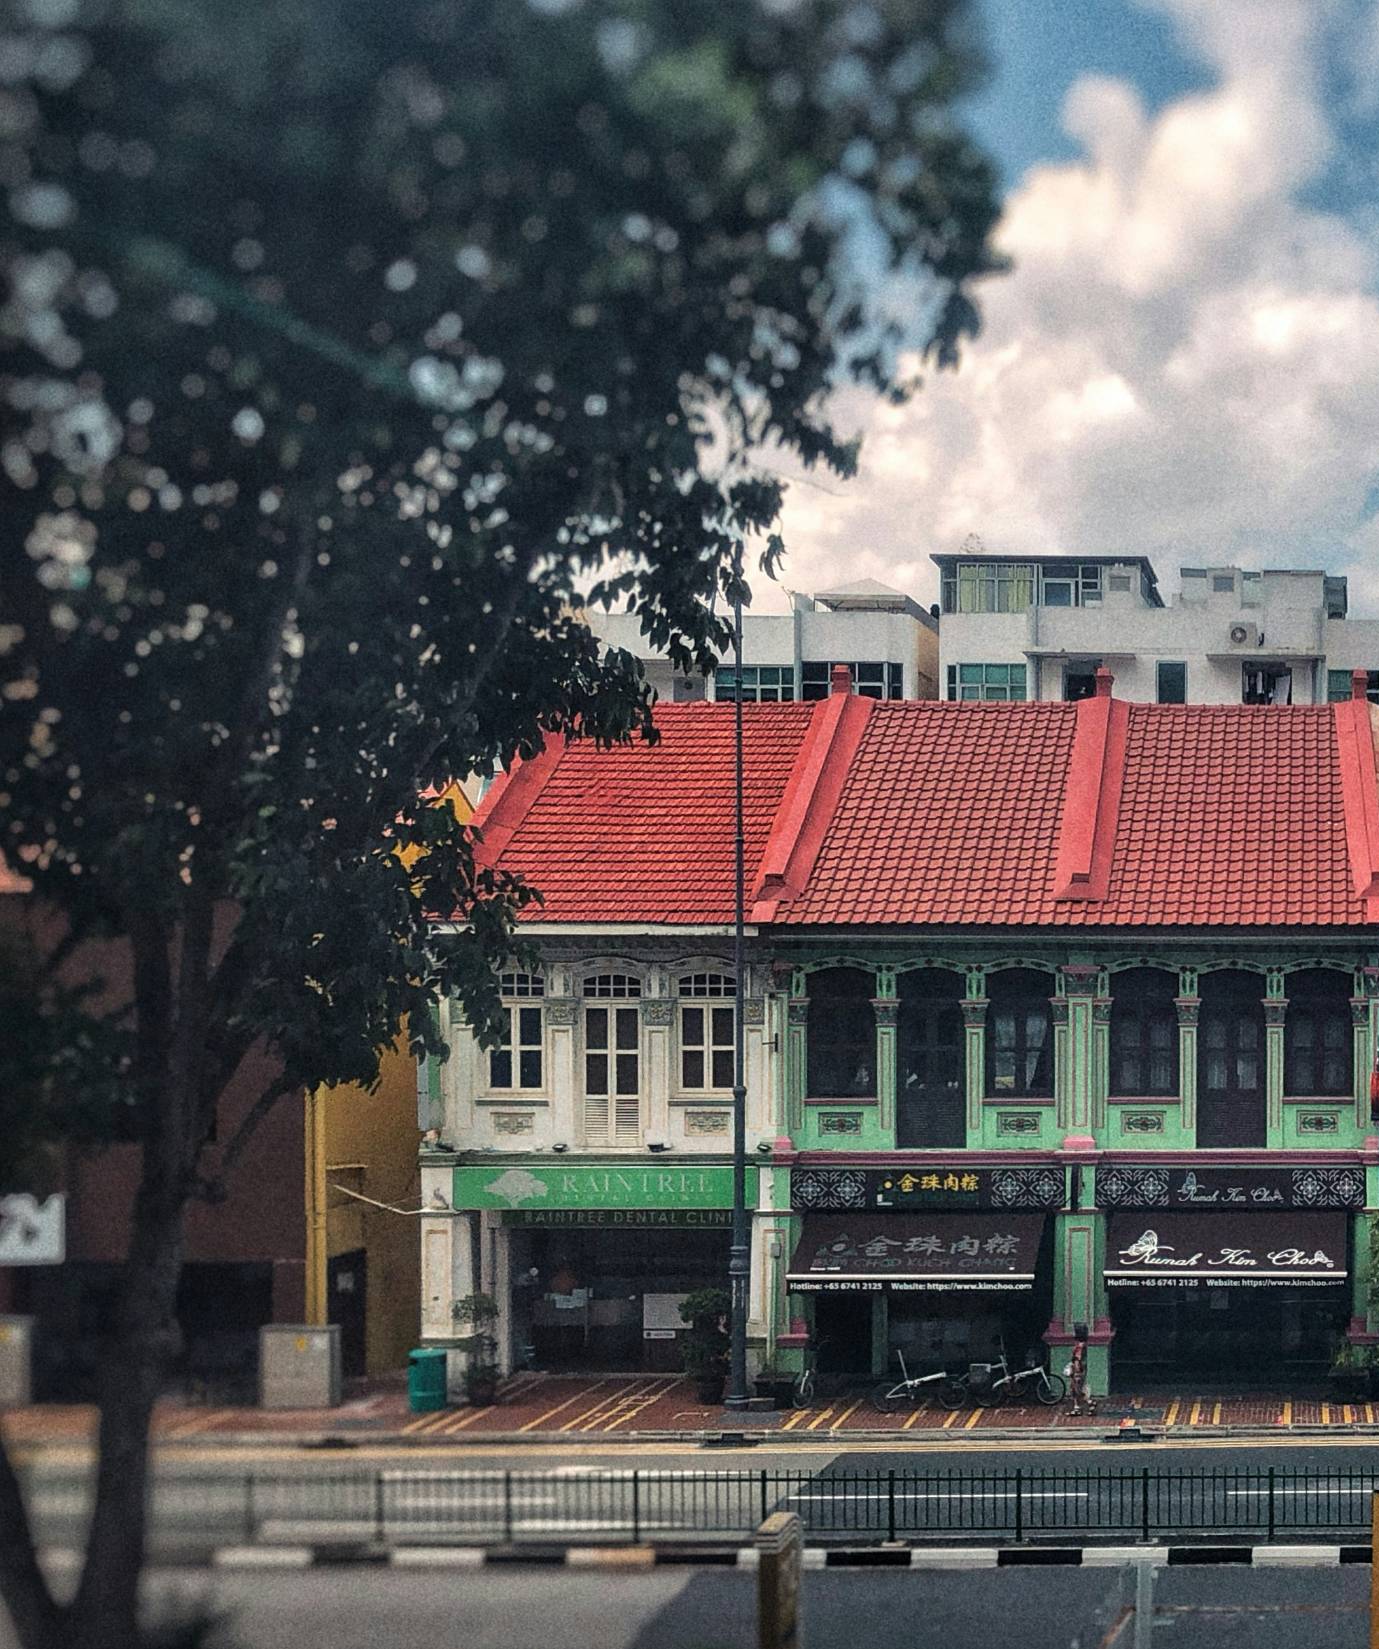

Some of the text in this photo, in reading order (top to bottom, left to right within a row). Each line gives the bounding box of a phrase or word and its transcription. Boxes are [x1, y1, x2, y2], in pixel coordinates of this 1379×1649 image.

[562, 1173, 713, 1193] RAINTREE
[897, 1172, 979, 1192] 金珠肉粽
[1178, 1185, 1218, 1201] Rumah
[1221, 1187, 1246, 1201] Kim
[524, 1212, 733, 1223] RAINTREE DENTAL CLINI
[858, 1233, 1021, 1257] 金珠肉粽
[1119, 1246, 1203, 1265] Rumah
[1208, 1248, 1257, 1265] Kim
[790, 1282, 823, 1291] Hotline:
[823, 1283, 839, 1291] +65
[840, 1283, 861, 1291] 6741
[862, 1283, 883, 1291] 2125
[891, 1282, 926, 1291] Website:
[1107, 1278, 1139, 1287] Hotline:
[1140, 1279, 1156, 1287] +65
[1157, 1279, 1177, 1287] 6741
[1178, 1279, 1199, 1287] 2125
[1206, 1279, 1241, 1287] Website:
